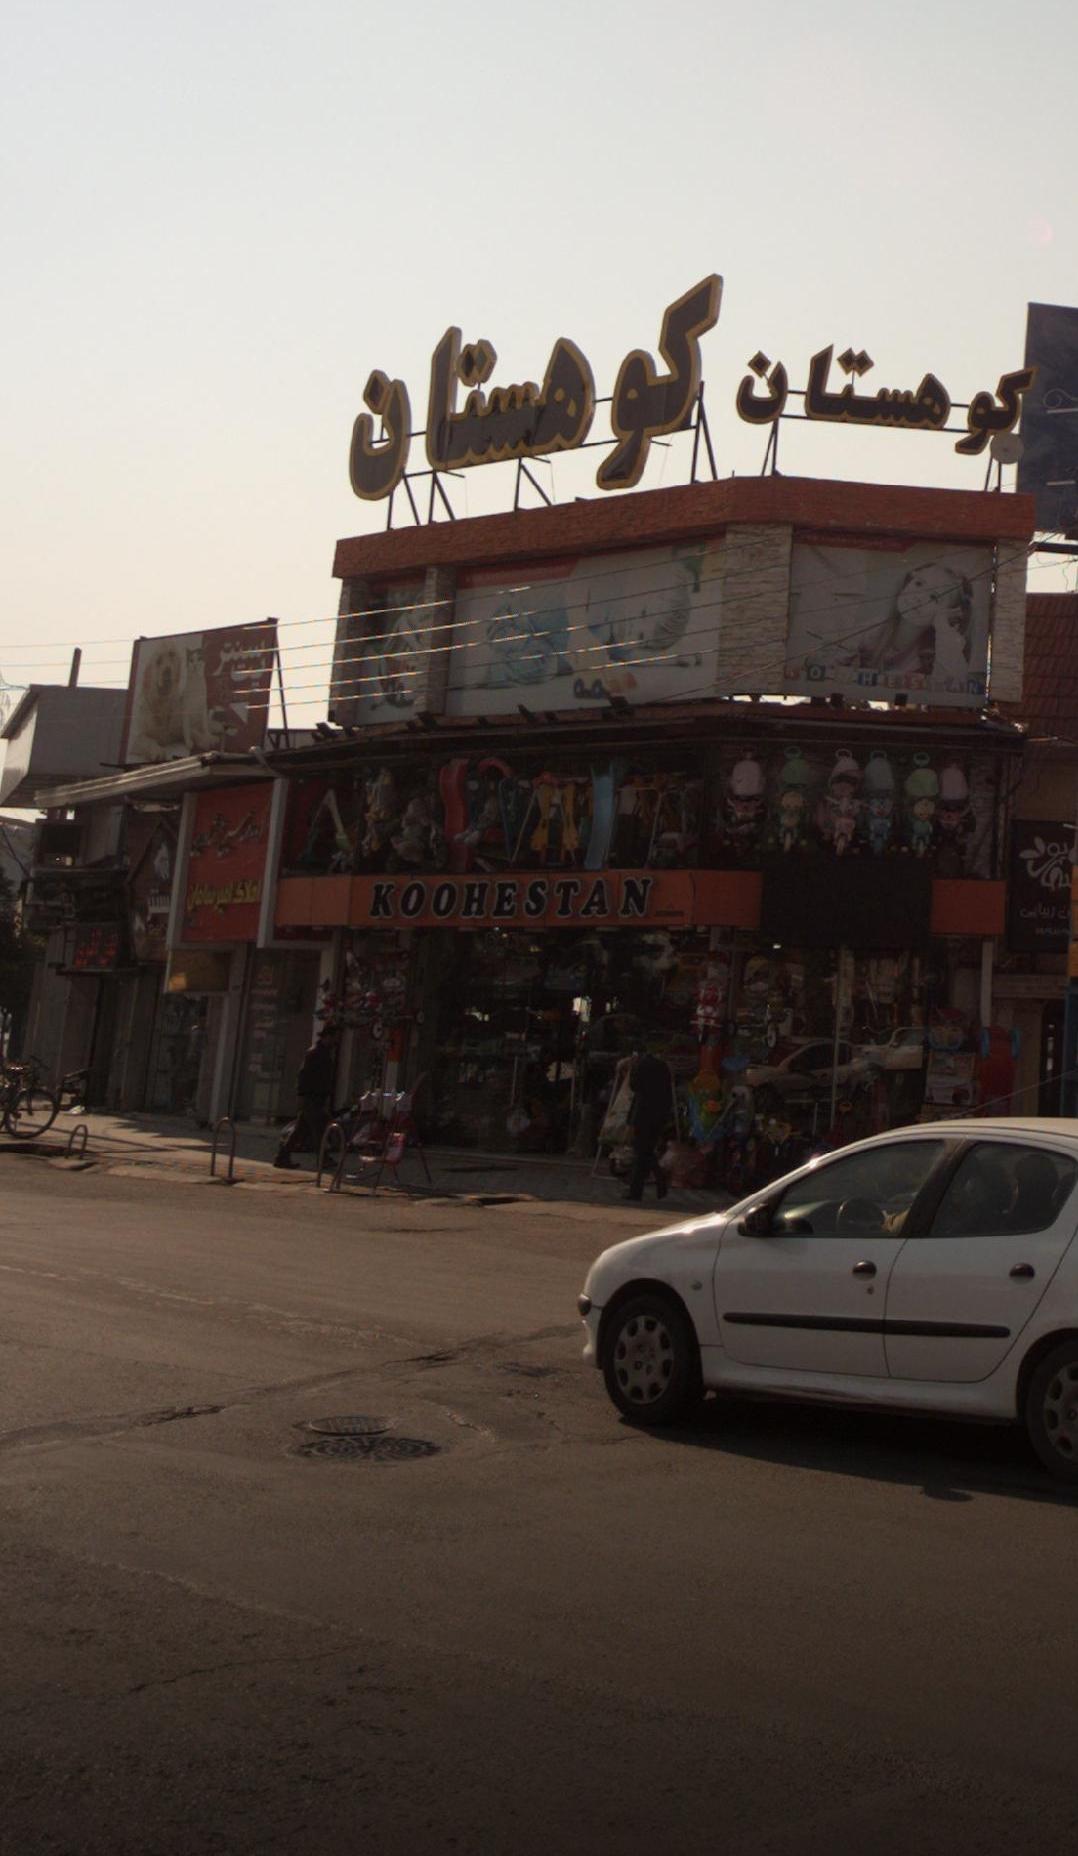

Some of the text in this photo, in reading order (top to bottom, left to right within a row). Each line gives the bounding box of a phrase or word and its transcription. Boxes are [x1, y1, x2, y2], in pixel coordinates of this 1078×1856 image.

[349, 273, 722, 500] کوهستان
[737, 344, 1039, 455] کوهستان
[368, 877, 654, 919] KOOHESTAN
